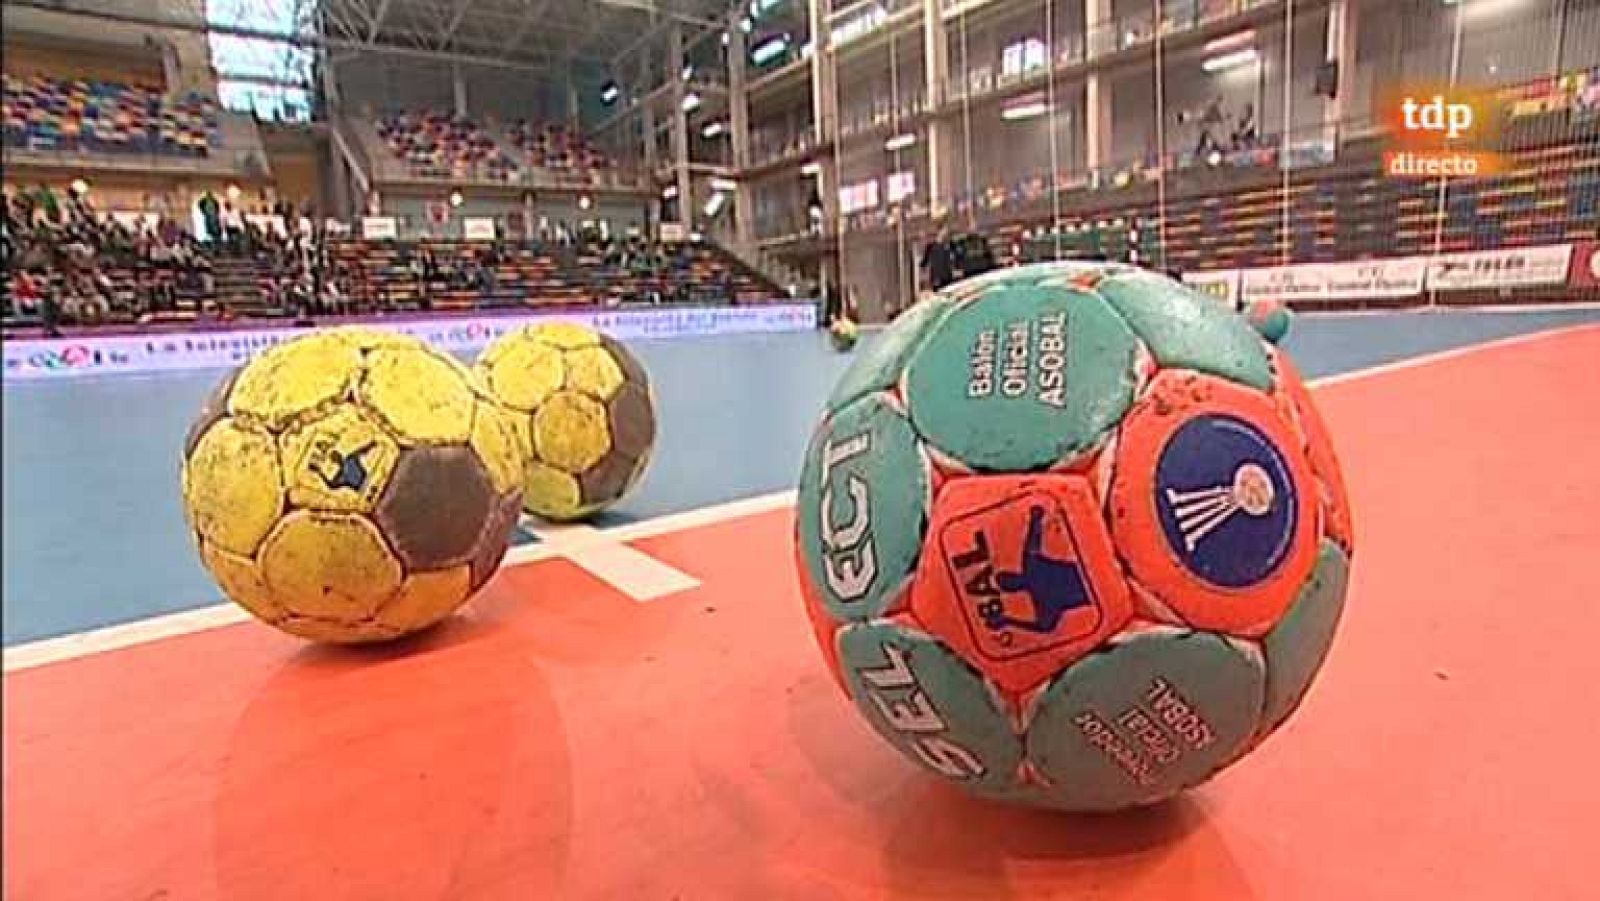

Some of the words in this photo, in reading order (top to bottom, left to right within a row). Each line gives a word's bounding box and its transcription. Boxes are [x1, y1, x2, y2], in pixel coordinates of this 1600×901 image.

[1003, 321, 1029, 395] Oficial
[1039, 312, 1066, 407] ASOBAL
[1148, 677, 1216, 750] ASOBAL
